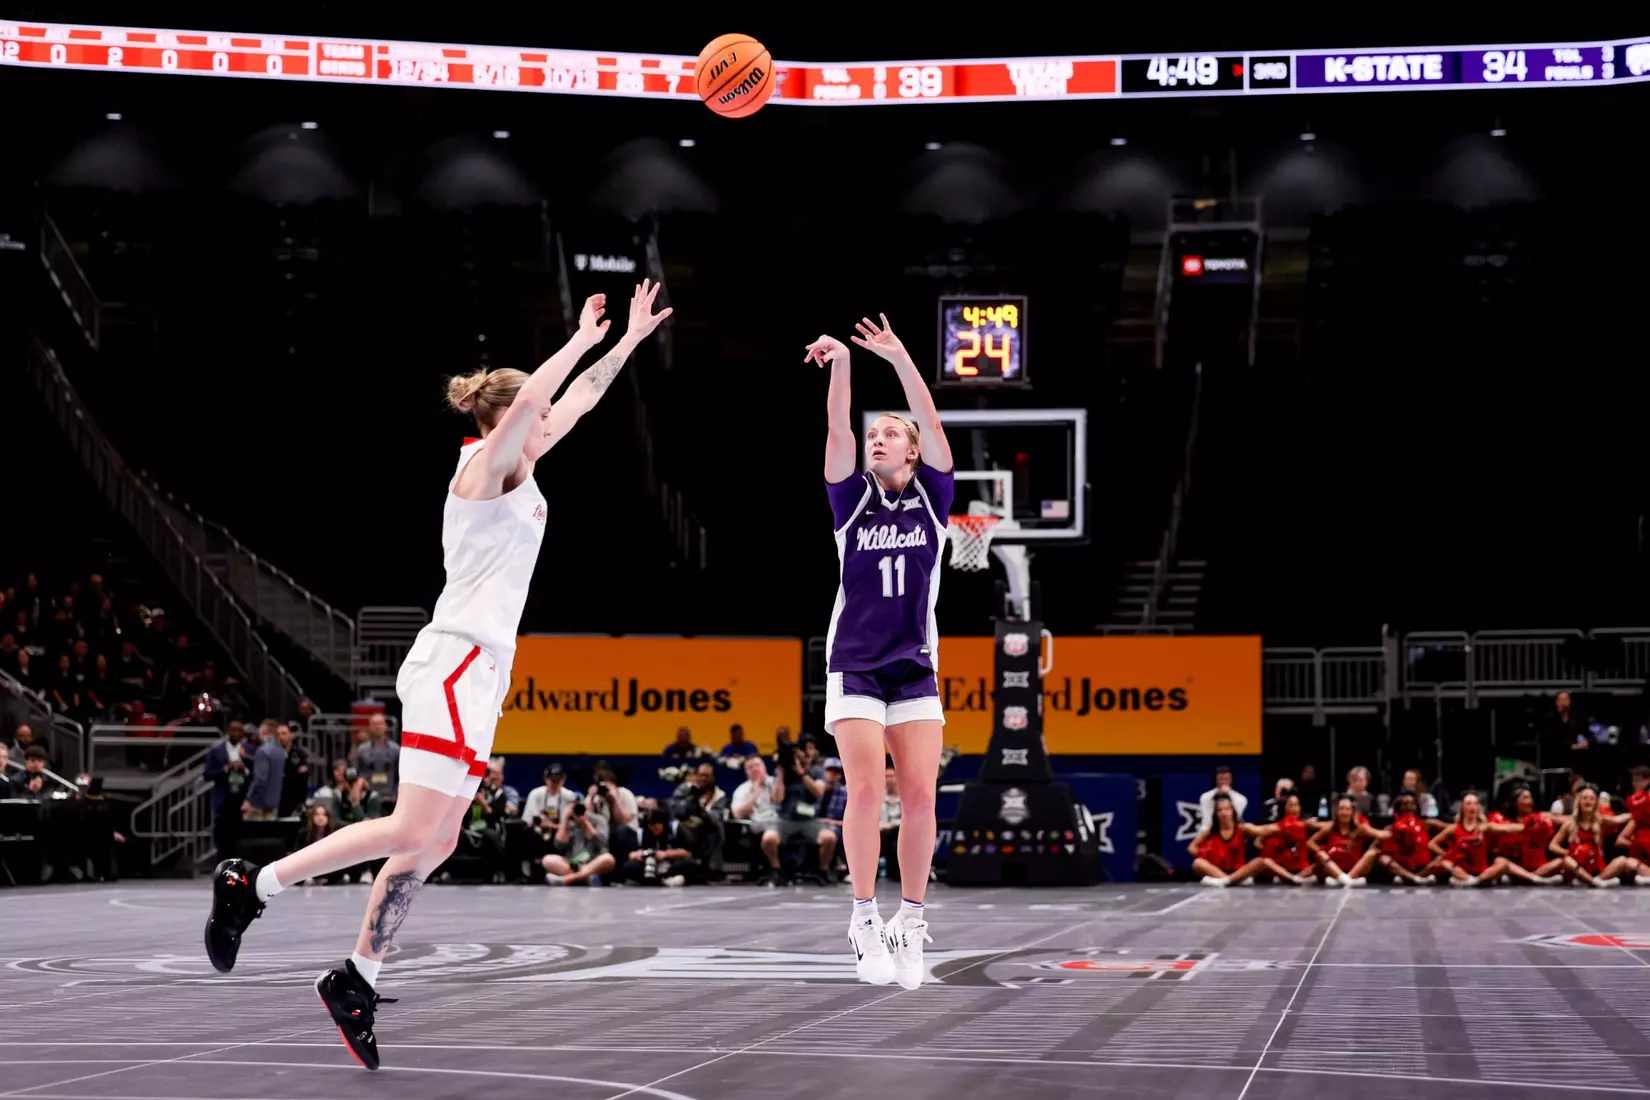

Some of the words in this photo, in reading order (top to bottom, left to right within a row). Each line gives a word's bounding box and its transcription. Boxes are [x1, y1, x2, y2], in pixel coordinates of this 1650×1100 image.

[50, 43, 67, 66] 0
[107, 46, 124, 67] 2
[161, 49, 178, 71] 0
[212, 52, 229, 73] 0
[266, 54, 283, 76] 0
[1146, 55, 1219, 87] 4:49
[1324, 54, 1443, 83] K-STATE
[1482, 50, 1528, 82] 34
[665, 75, 682, 96] 7
[718, 67, 765, 105] Wilson
[898, 66, 943, 98] 39
[963, 304, 1018, 329] 4:49
[954, 330, 1011, 376] 24
[856, 524, 928, 551] Wildcats
[878, 553, 906, 598] 11
[623, 678, 733, 717] Jones
[1076, 677, 1189, 717] Jones
